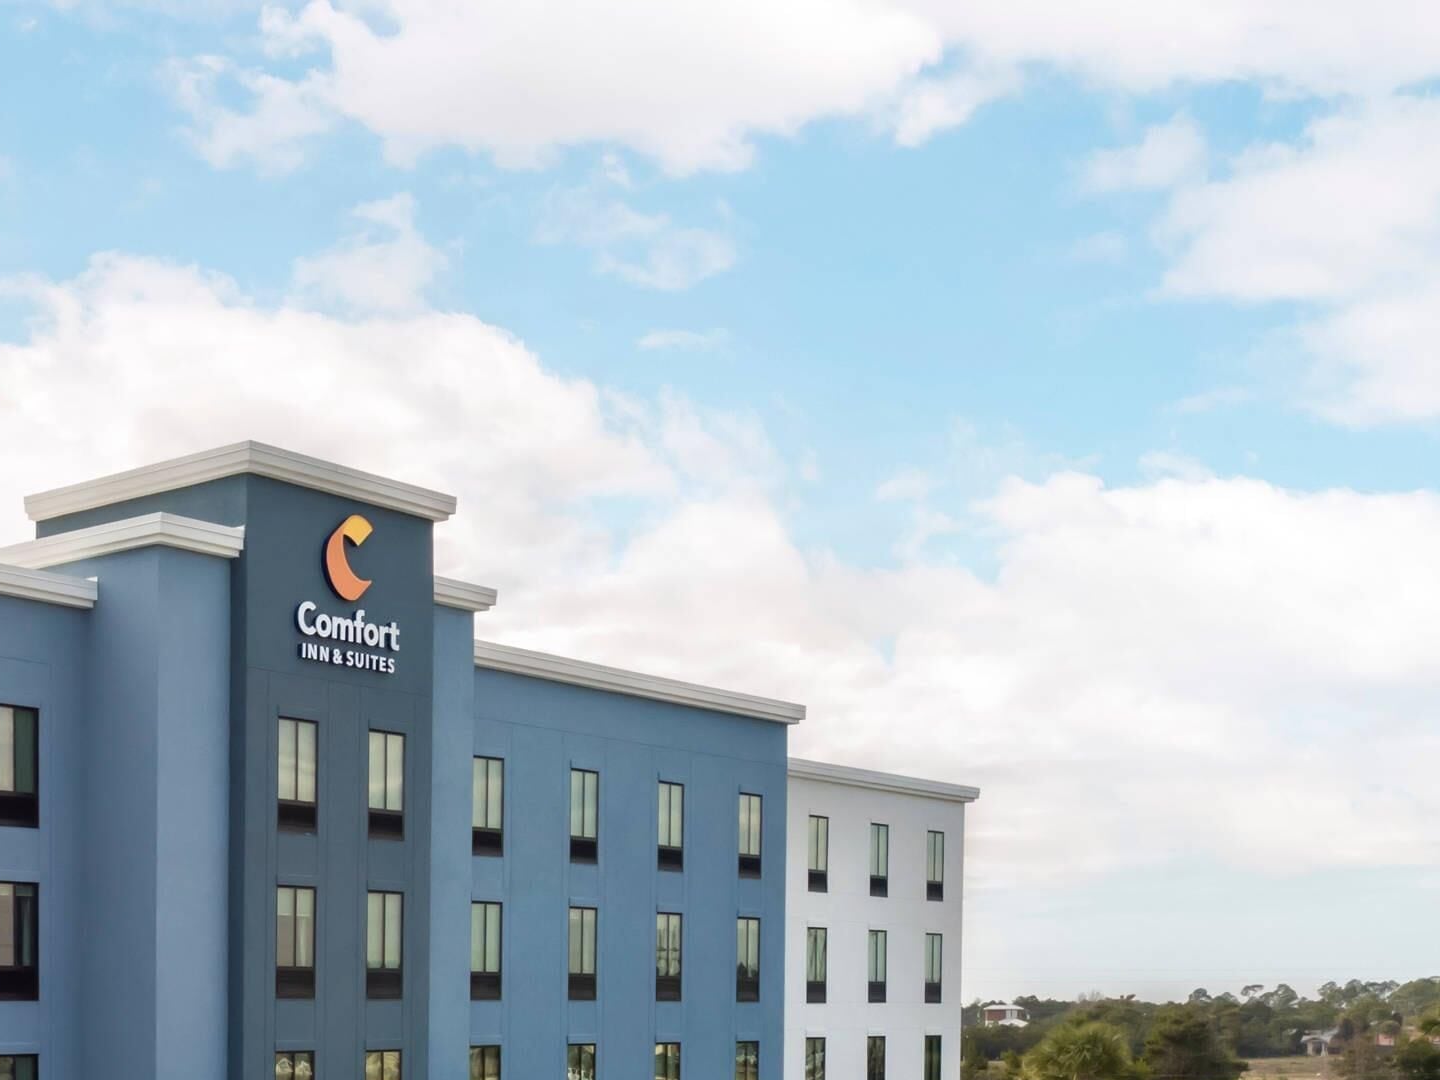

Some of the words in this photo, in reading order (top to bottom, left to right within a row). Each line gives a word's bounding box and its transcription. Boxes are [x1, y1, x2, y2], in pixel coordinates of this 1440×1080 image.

[298, 600, 400, 652] Comfort
[302, 643, 330, 662] INN
[333, 648, 344, 665] &
[346, 650, 396, 674] SUITES
